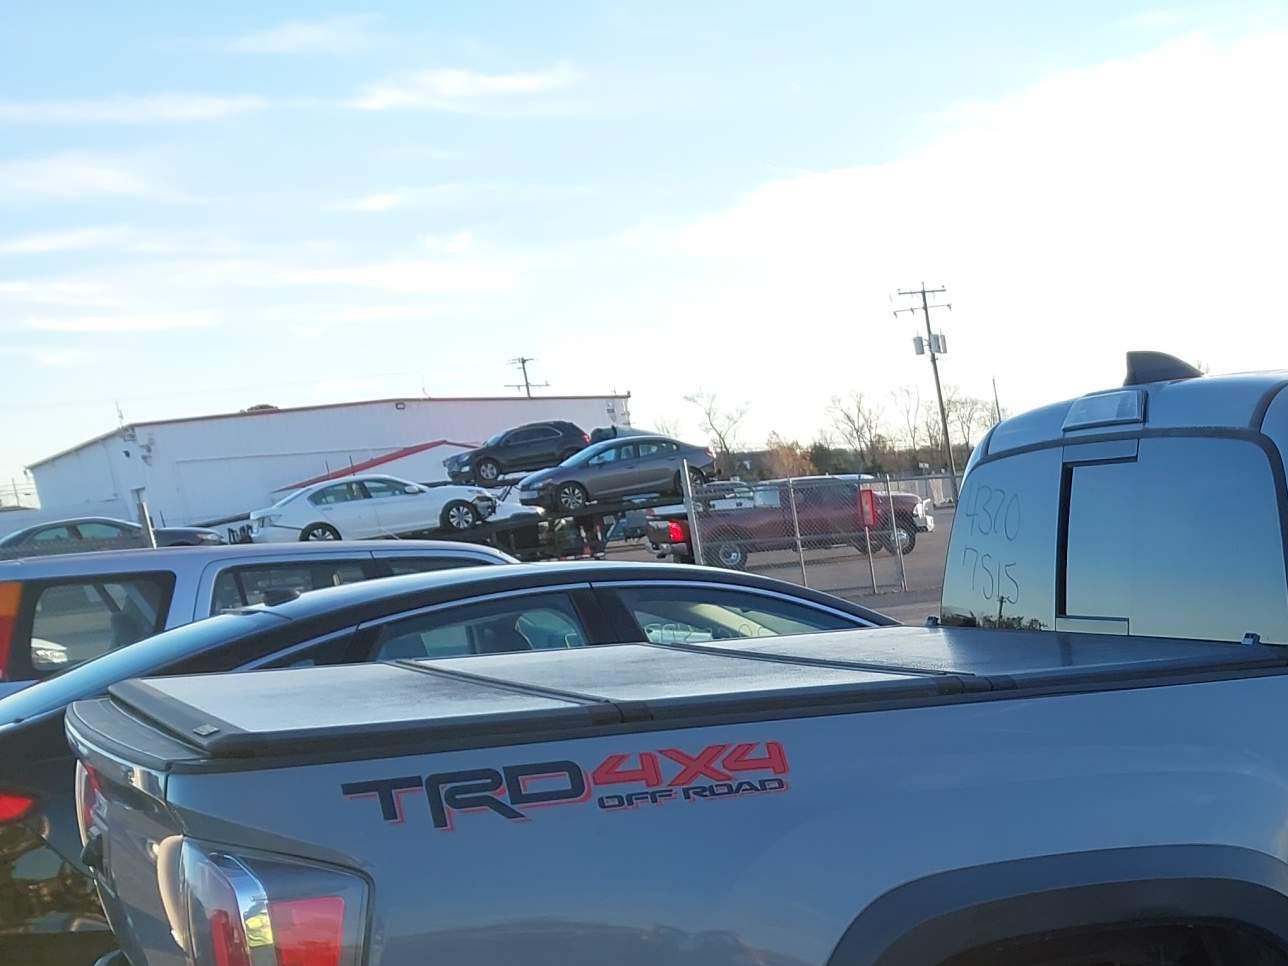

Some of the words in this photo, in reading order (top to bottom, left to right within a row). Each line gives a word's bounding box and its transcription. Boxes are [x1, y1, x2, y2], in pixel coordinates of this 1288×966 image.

[965, 480, 1022, 542] 4370
[961, 546, 1020, 605] 7515
[341, 759, 592, 832] TRD
[598, 788, 674, 811] OFF
[682, 777, 788, 802] ROAD
